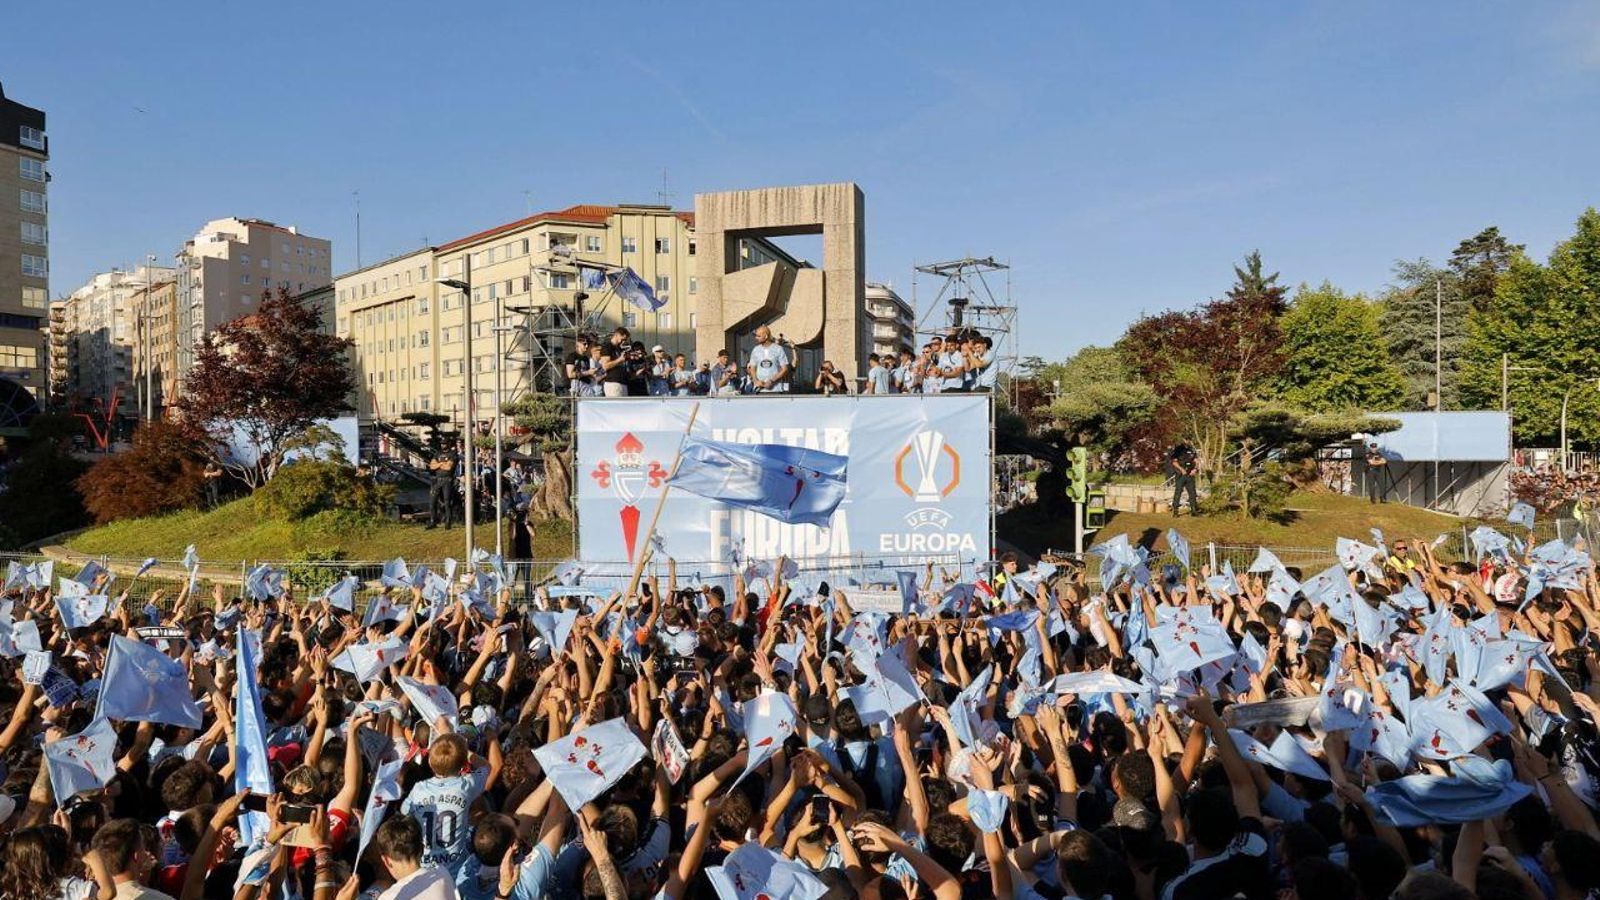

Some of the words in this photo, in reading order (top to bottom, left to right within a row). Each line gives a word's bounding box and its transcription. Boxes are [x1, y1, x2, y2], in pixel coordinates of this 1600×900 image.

[907, 511, 949, 527] UEFA
[880, 532, 977, 552] EUROPA
[438, 794, 467, 809] ASPAS
[421, 810, 457, 849] 10
